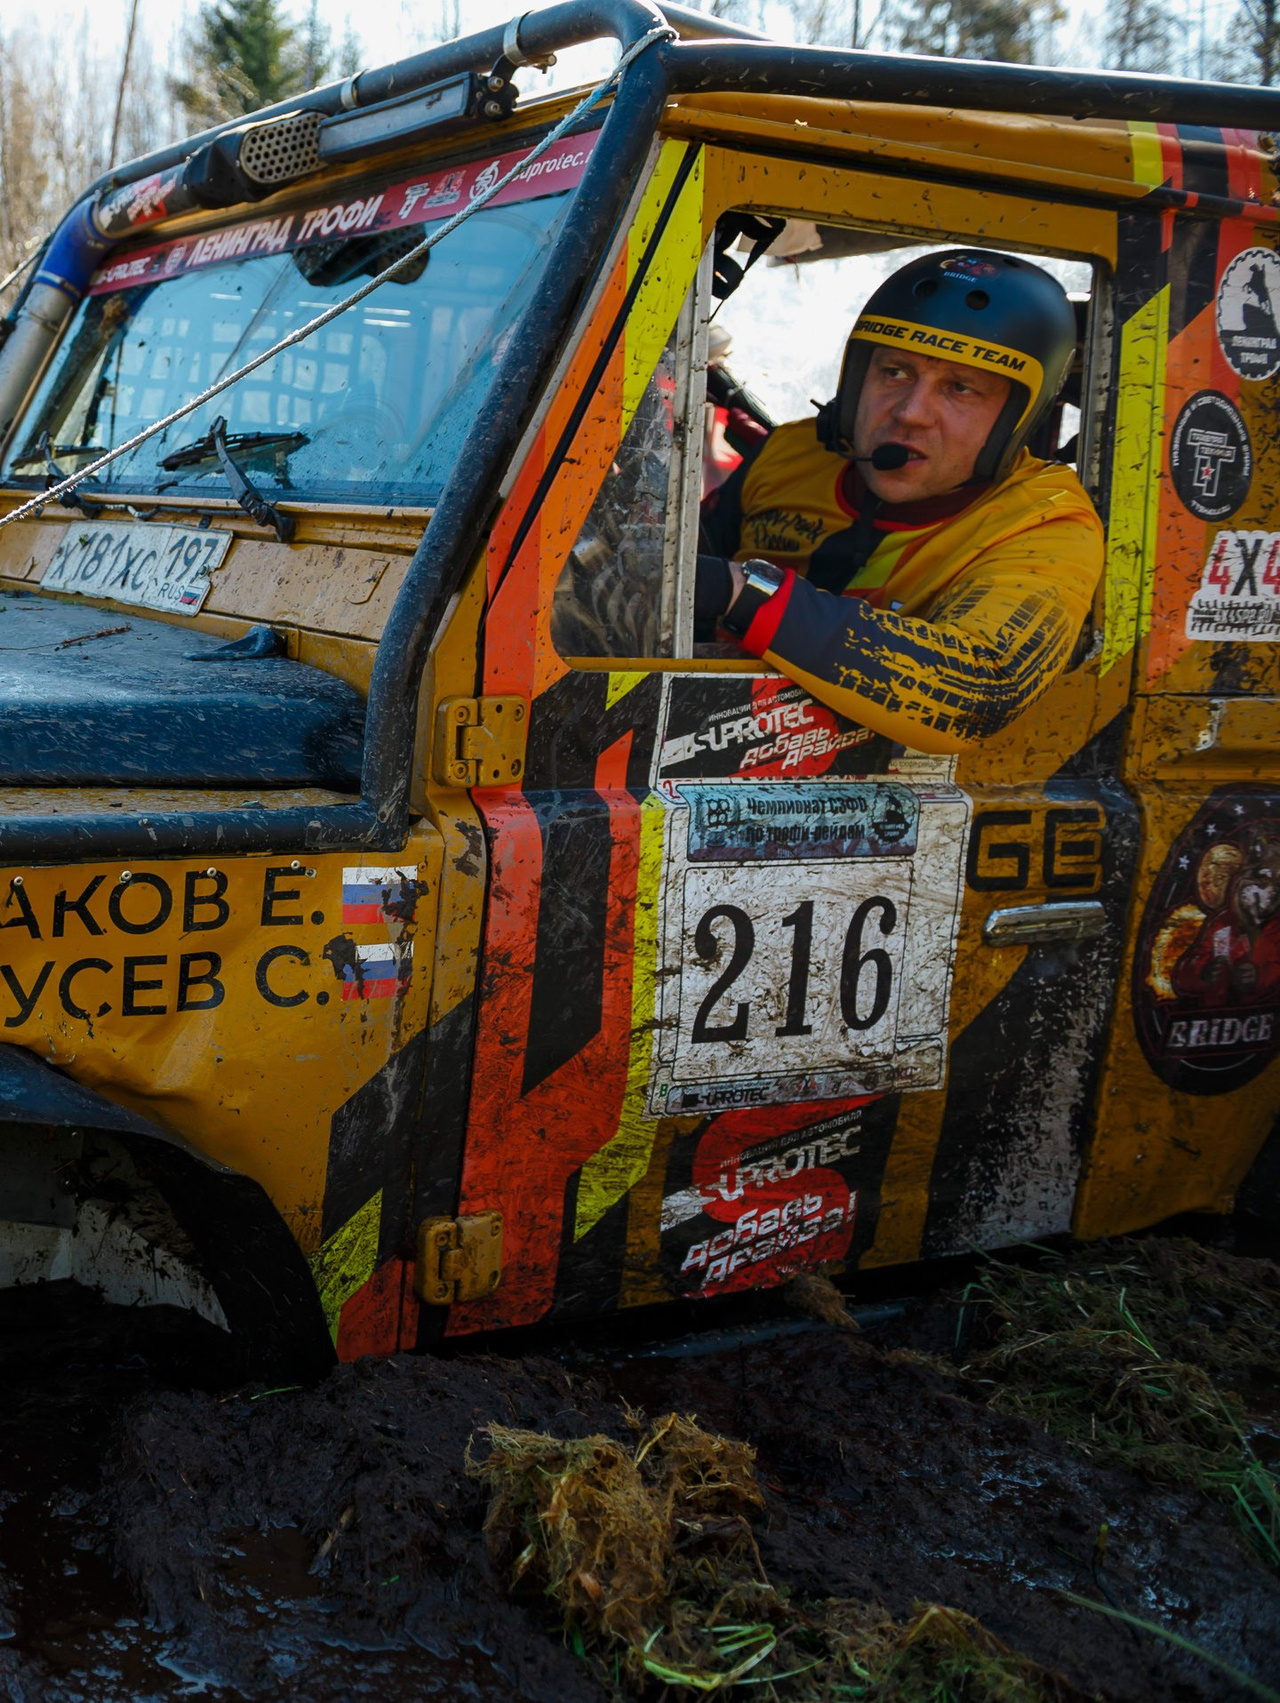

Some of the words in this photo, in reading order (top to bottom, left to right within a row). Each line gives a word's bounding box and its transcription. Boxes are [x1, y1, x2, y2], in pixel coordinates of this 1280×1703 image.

[186, 216, 291, 268] ЛЕНИНГРАД
[297, 194, 384, 241] ТРОФИ
[910, 330, 969, 354] RACE
[971, 345, 1027, 372] TEAM
[164, 534, 219, 584] 197
[157, 582, 185, 601] RUS
[747, 798, 825, 816] Чемпионат
[829, 796, 868, 814] СЗФО
[260, 866, 326, 927] Е.
[254, 944, 331, 1008] С.
[691, 896, 898, 1044] 216
